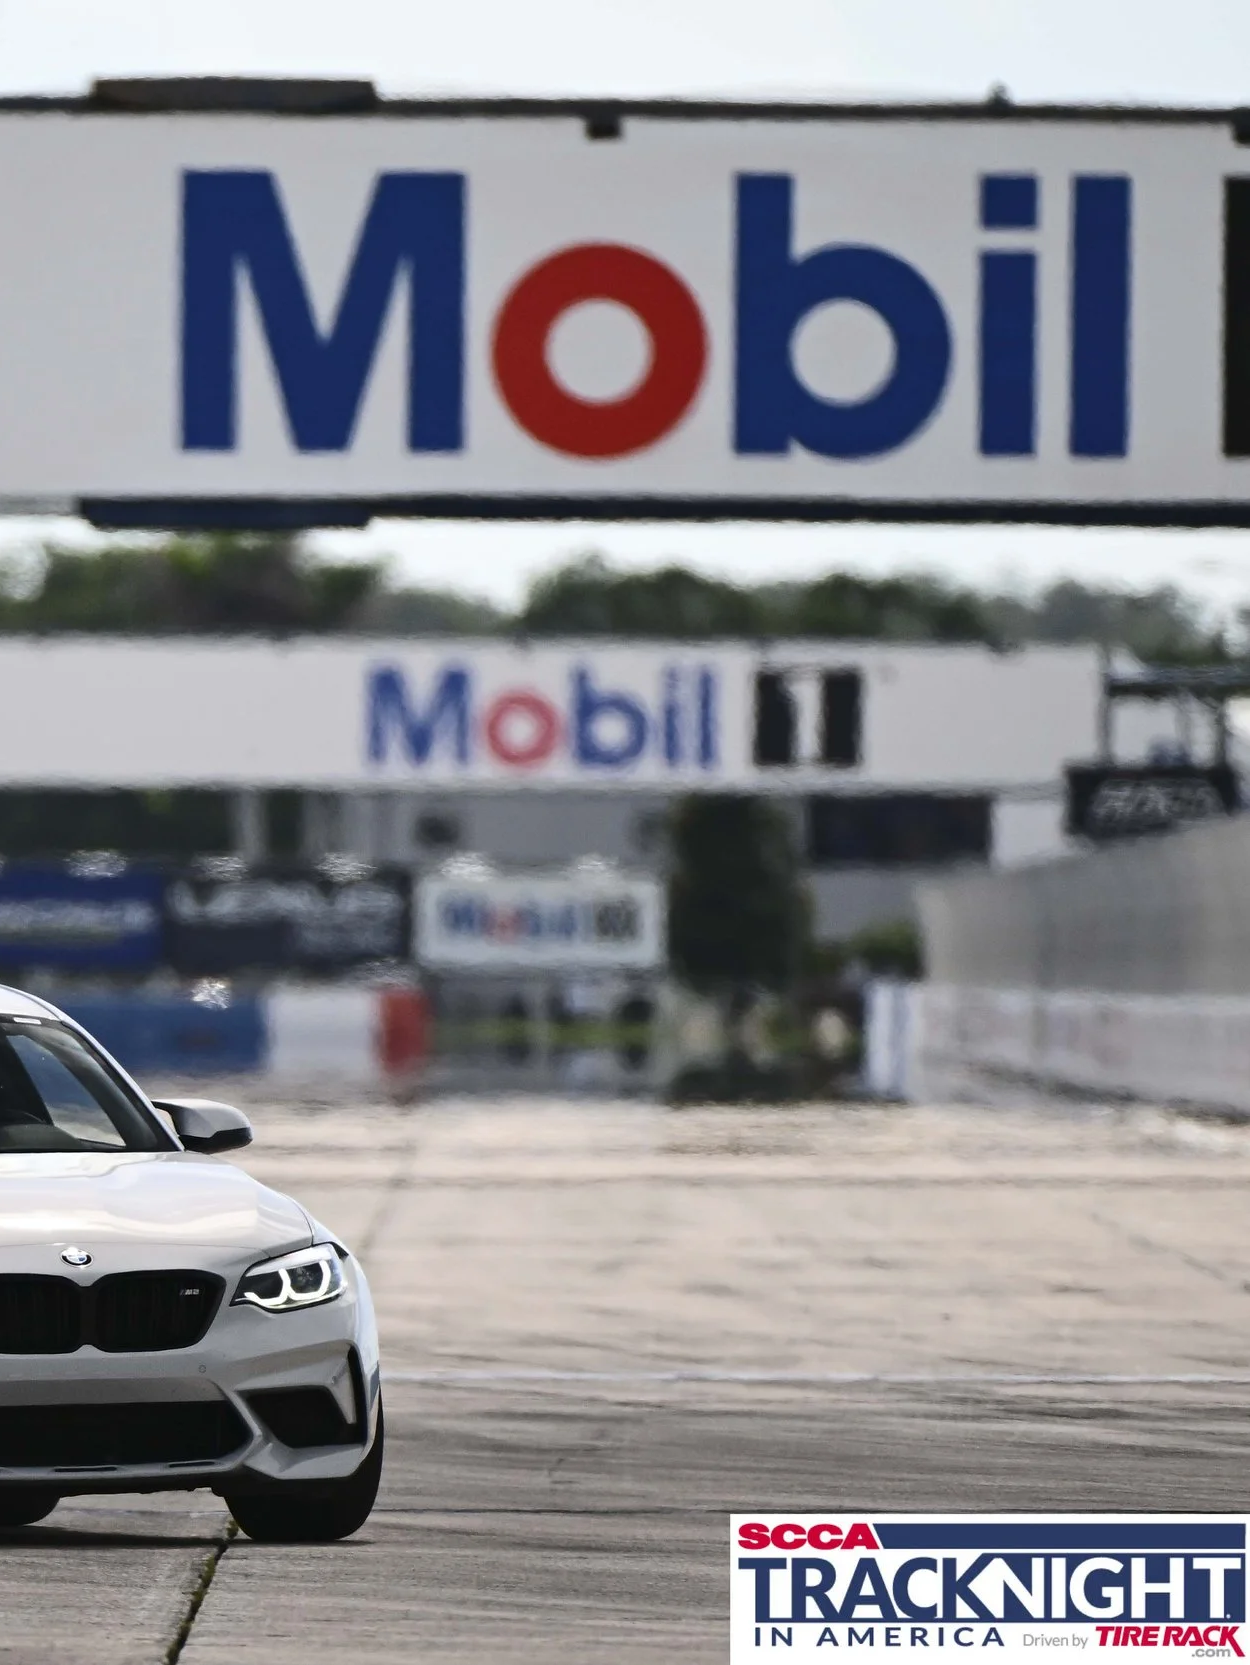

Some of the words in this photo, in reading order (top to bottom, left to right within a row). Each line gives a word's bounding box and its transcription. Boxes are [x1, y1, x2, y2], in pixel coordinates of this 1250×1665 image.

[179, 168, 1132, 461] Mobil
[366, 662, 716, 770] Mobil
[783, 673, 825, 762] 1
